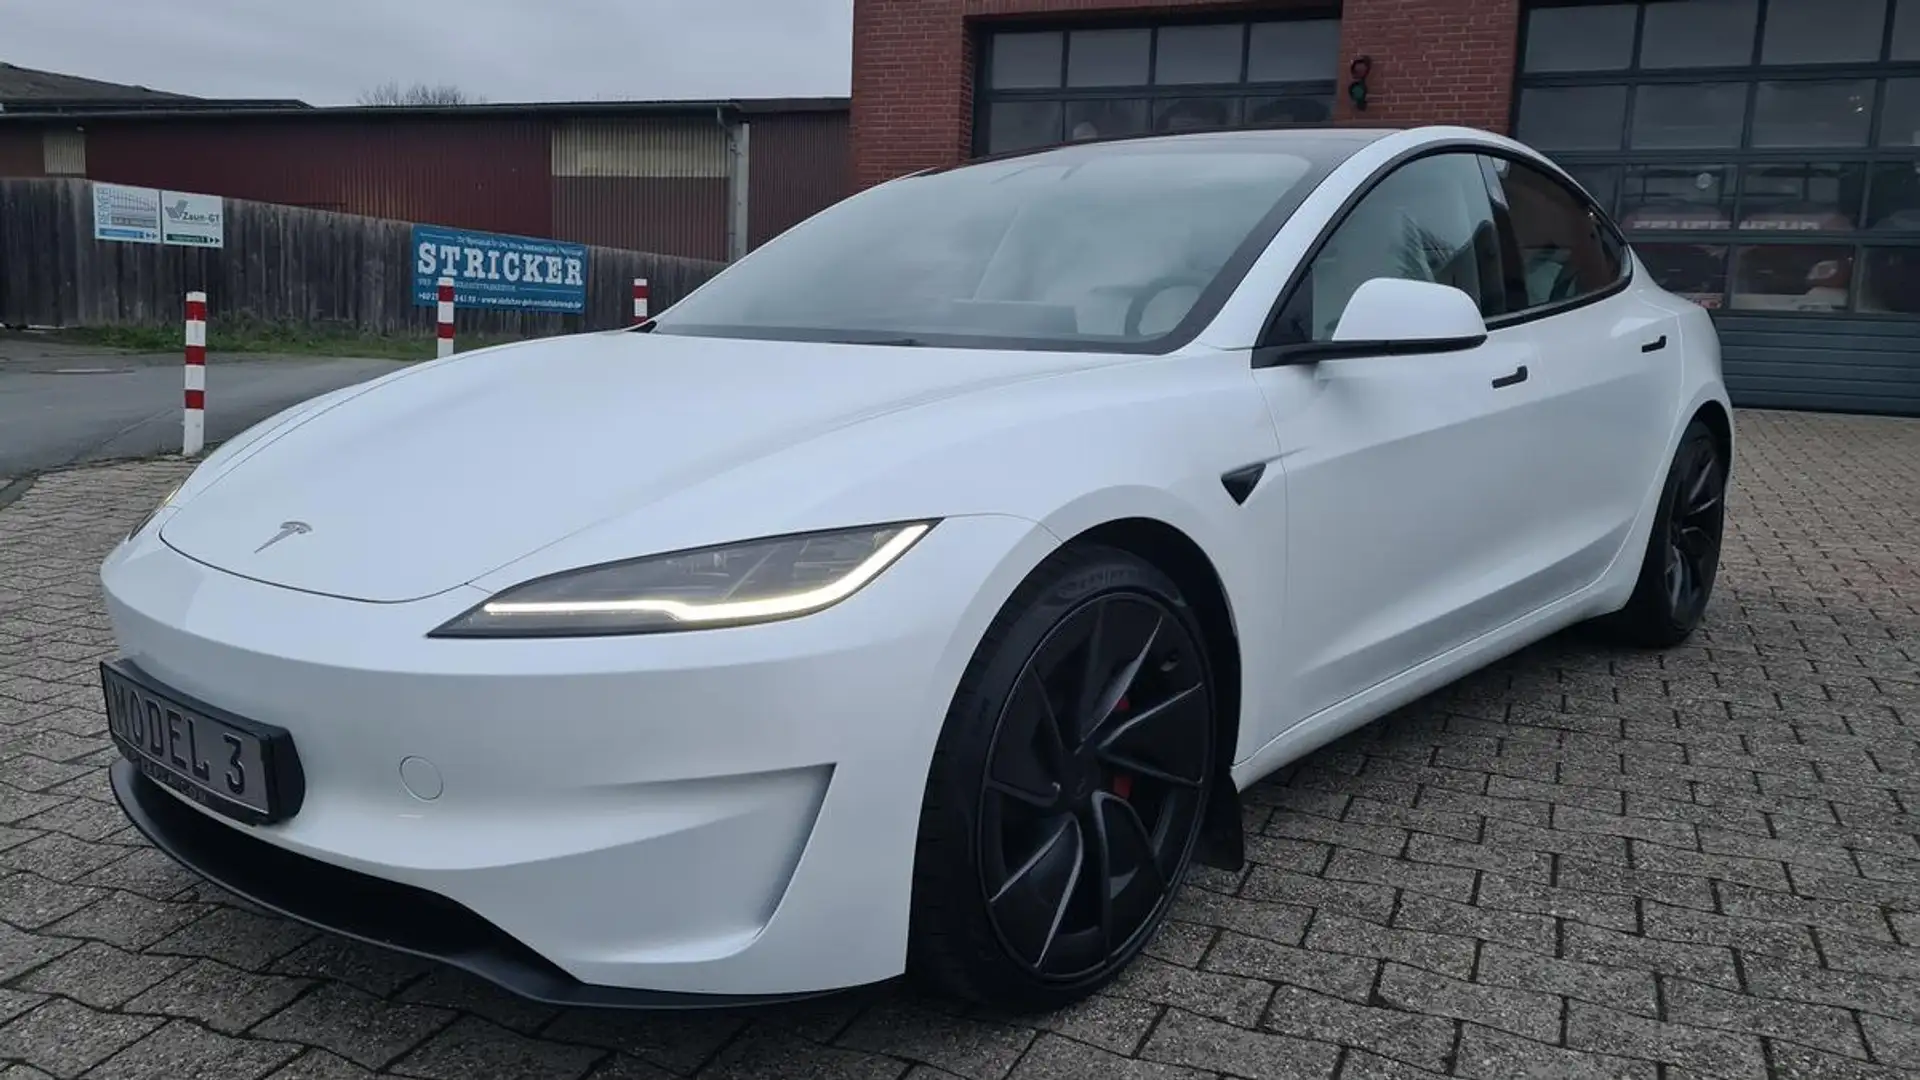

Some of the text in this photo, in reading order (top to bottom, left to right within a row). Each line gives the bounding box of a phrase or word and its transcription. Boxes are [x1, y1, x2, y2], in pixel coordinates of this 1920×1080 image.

[417, 242, 583, 285] STRICKER
[111, 680, 210, 782] MODEL
[222, 731, 245, 795] 3
